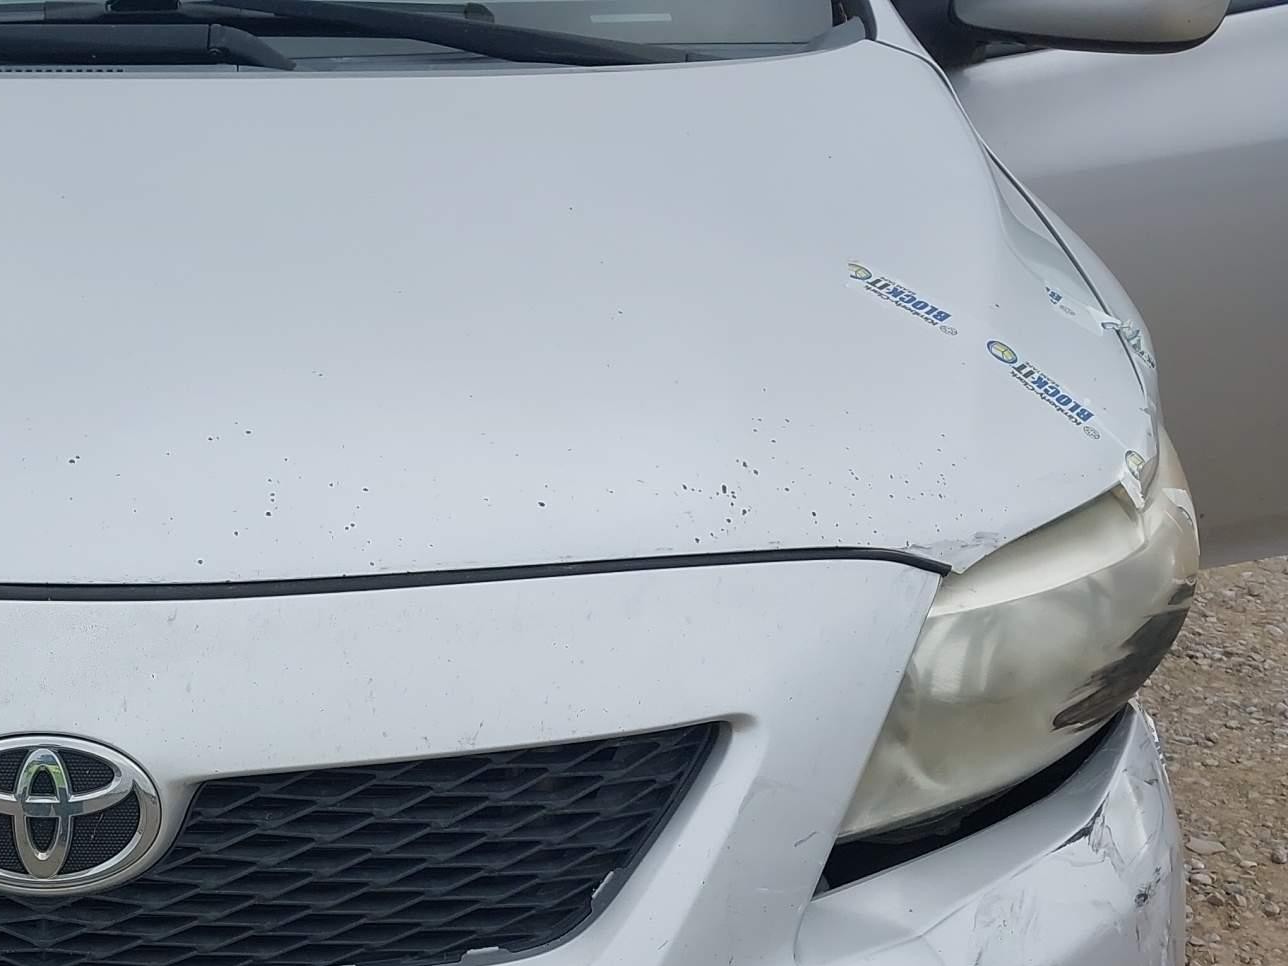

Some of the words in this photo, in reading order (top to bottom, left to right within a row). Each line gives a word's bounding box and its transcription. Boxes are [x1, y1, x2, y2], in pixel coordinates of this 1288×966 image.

[864, 285, 939, 326] Kimberly-Clark
[866, 278, 952, 322] BLOCK-IT
[1011, 370, 1082, 426] Kimberly-Clark
[1012, 363, 1095, 422] BLOCK-IT
